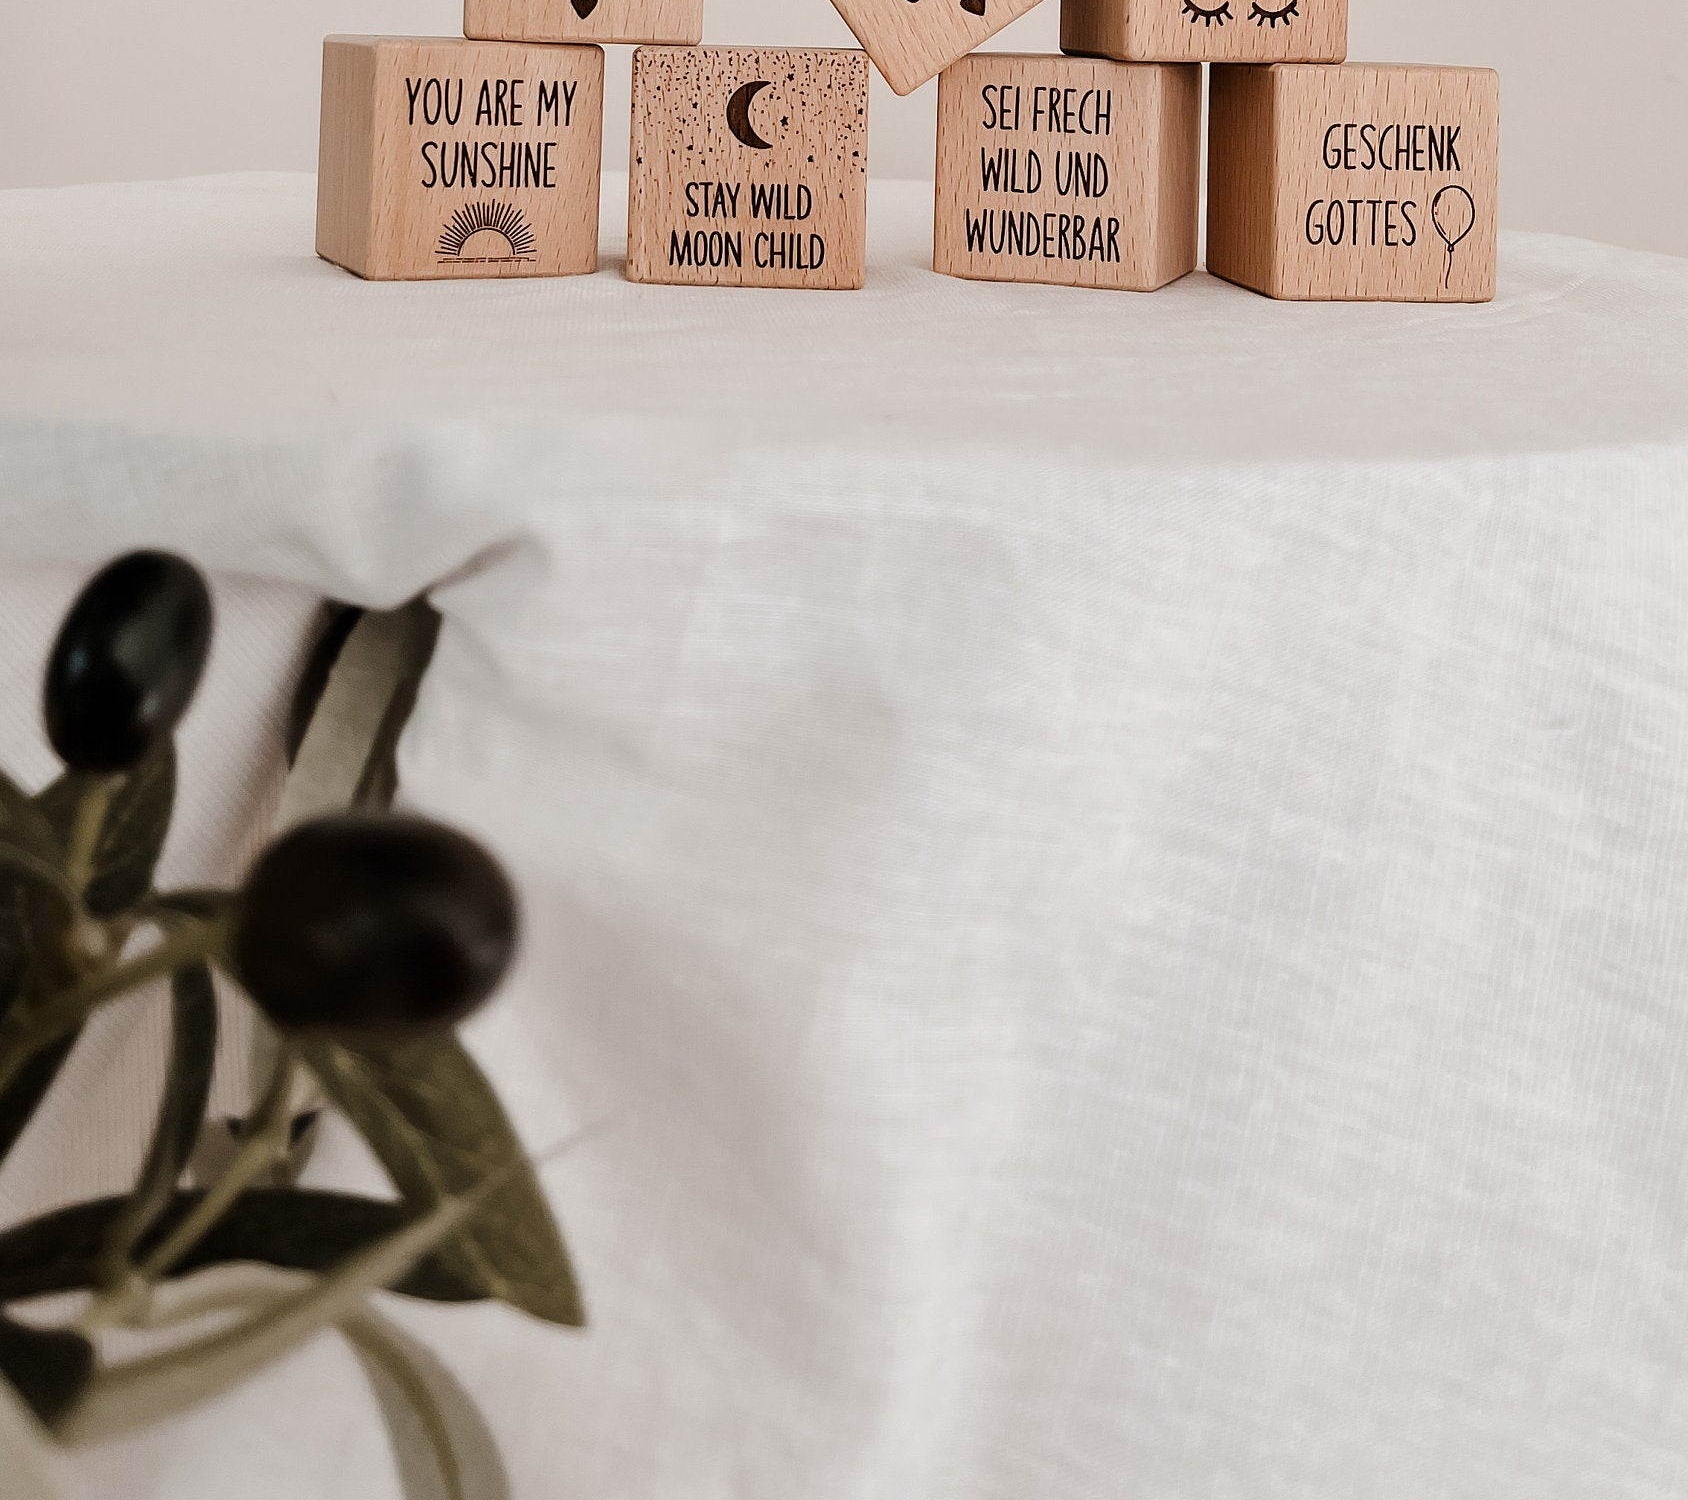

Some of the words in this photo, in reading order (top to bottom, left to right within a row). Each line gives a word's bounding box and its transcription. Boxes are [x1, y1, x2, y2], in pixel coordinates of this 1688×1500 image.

[405, 77, 463, 126] YOU
[475, 79, 524, 127] ARE
[536, 79, 578, 127] MY
[981, 84, 1021, 131] SEI
[1032, 86, 1111, 136] FRECH
[421, 141, 557, 188] SUNSHINE
[981, 146, 1042, 194] WILD
[1055, 150, 1109, 199] UND
[1322, 123, 1461, 173] GESCHENK
[685, 181, 741, 220] STAY
[750, 182, 812, 221] WILD
[1305, 199, 1417, 248] GOTTES
[668, 230, 742, 269] MOON
[754, 230, 825, 270] CHILD
[965, 208, 1121, 263] WUNDERBAR
